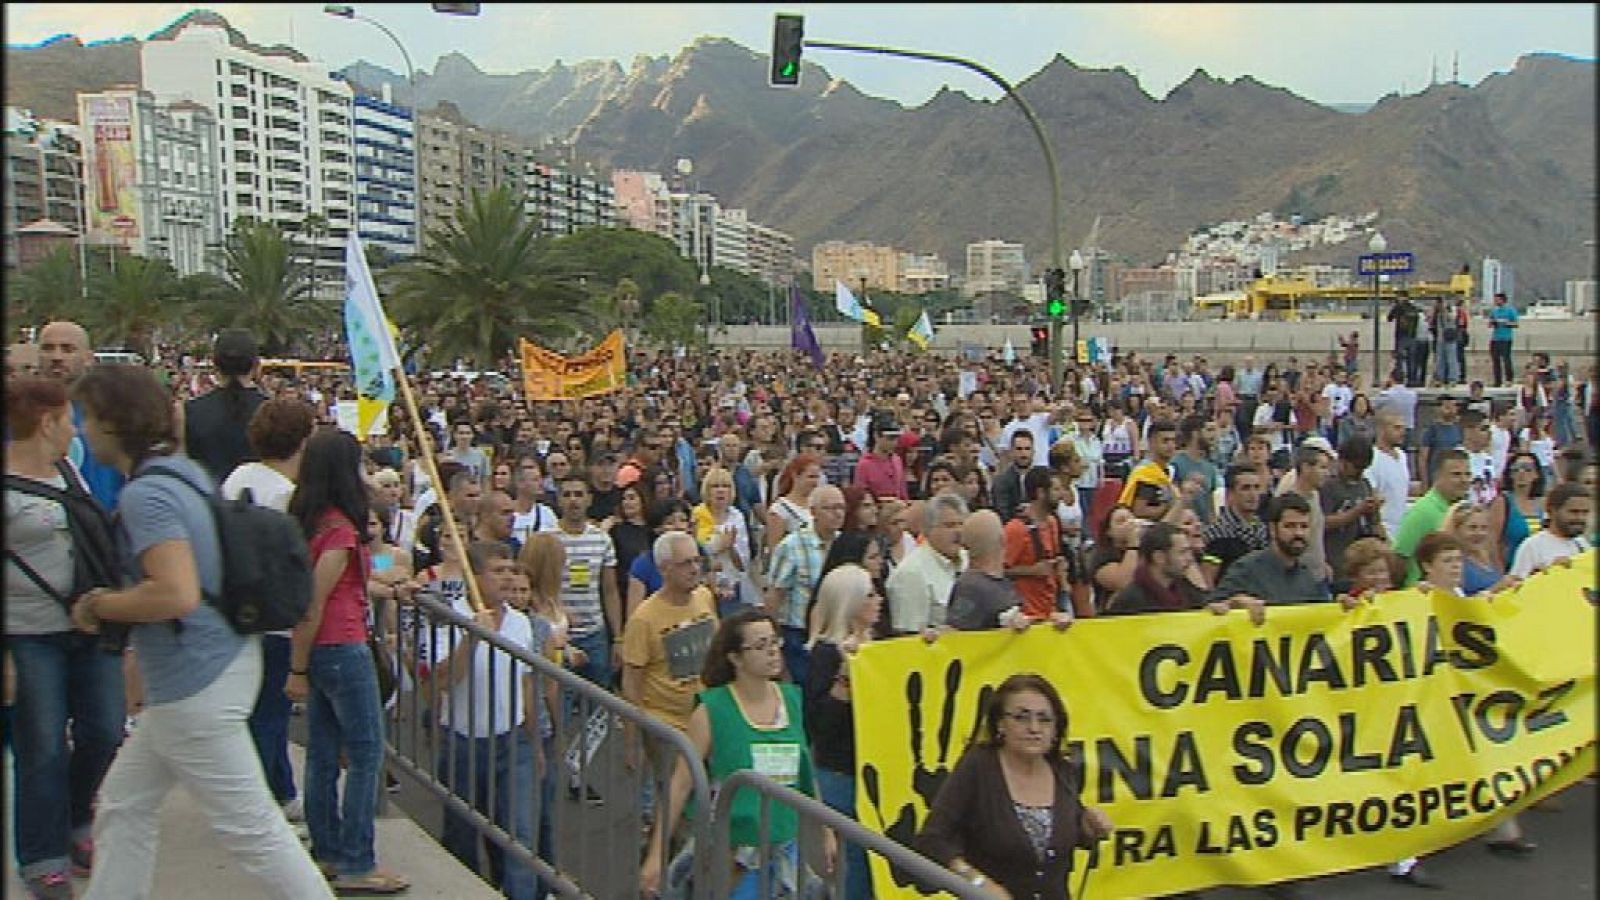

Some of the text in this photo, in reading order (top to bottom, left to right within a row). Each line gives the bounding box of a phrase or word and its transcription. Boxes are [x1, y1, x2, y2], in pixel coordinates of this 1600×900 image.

[1138, 616, 1498, 710] CANARIAS
[1231, 704, 1434, 785] SOLA
[1195, 809, 1279, 855] LAS
